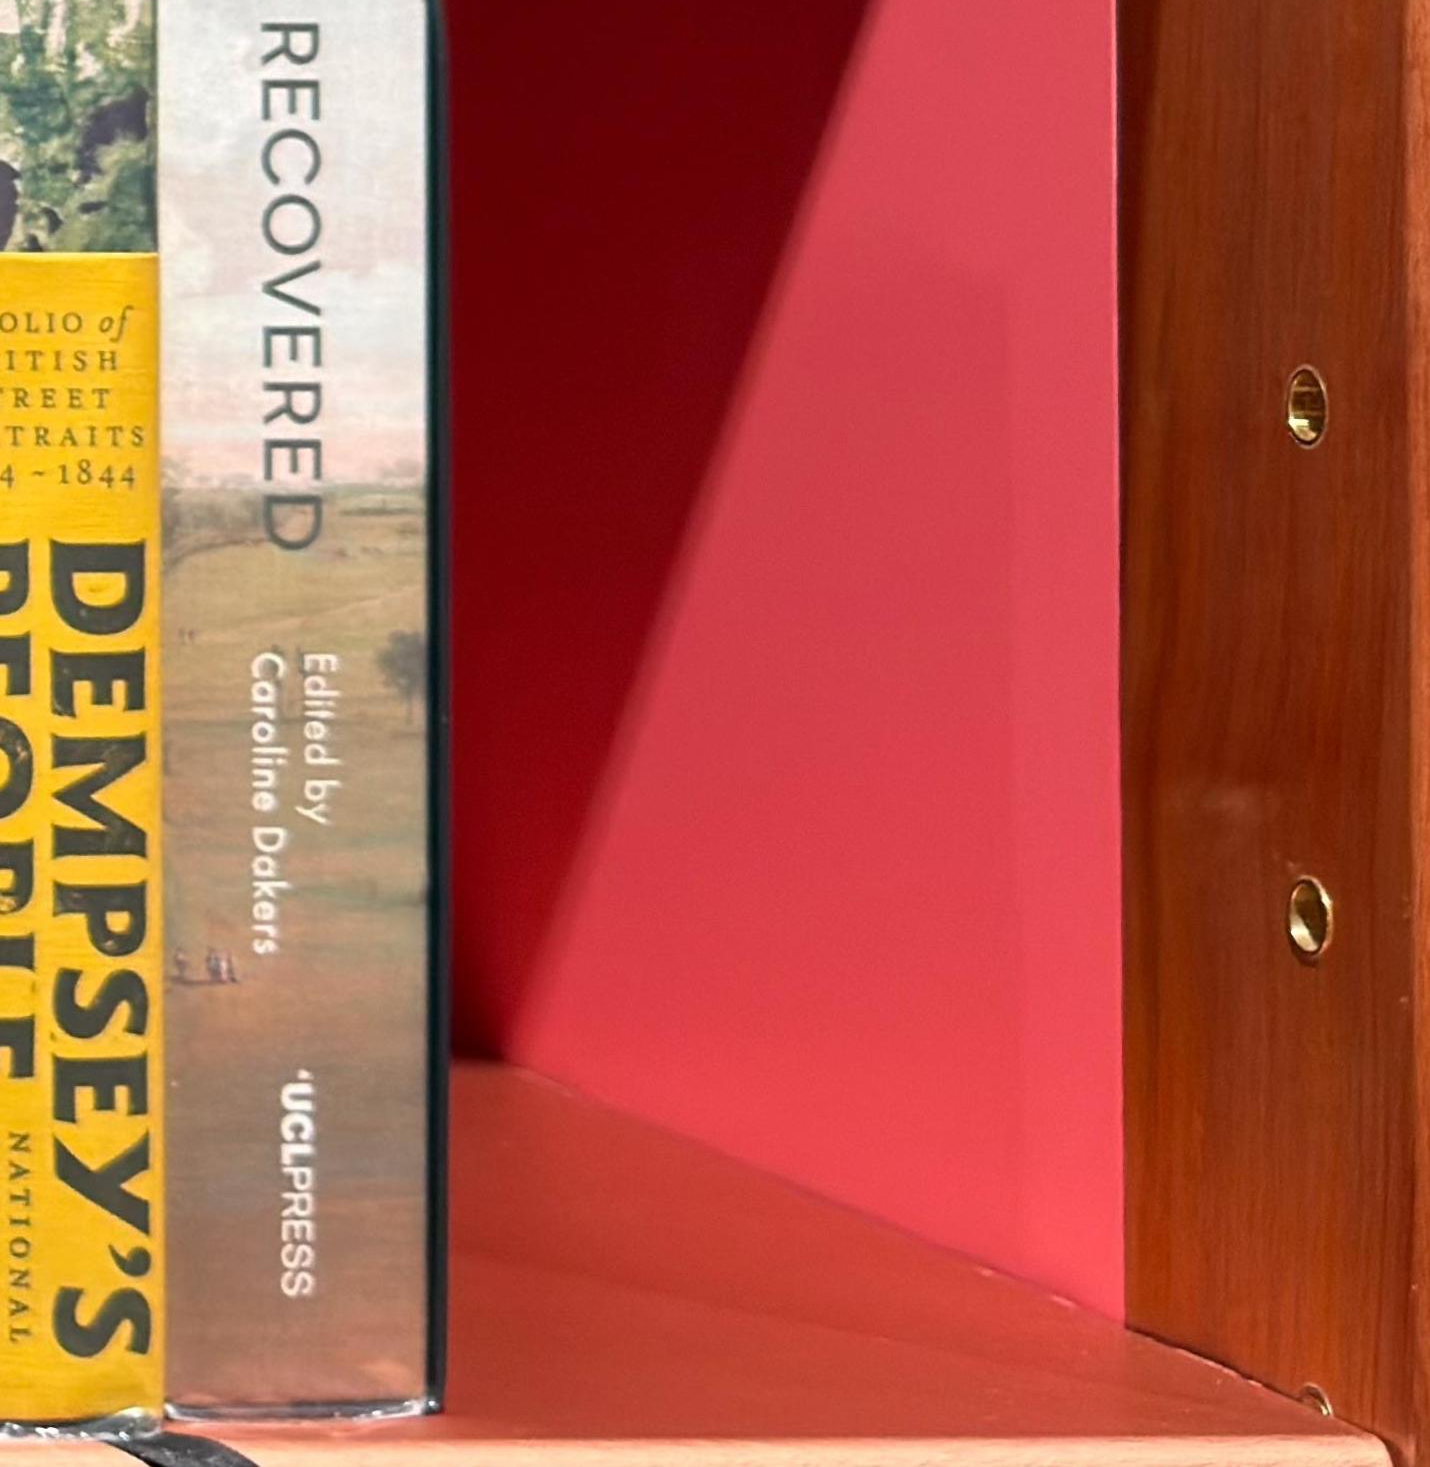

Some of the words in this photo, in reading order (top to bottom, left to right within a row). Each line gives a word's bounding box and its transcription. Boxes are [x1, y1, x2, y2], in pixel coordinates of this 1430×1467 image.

[99, 305, 134, 343] of
[260, 23, 322, 551] RECOVERED
[58, 459, 135, 489] 1844
[252, 652, 287, 813] Caroline
[303, 652, 341, 766] Edited
[296, 780, 341, 825] by
[50, 537, 152, 1357] DEMPSEY'S
[252, 826, 291, 955] Dakers
[8, 1131, 32, 1344] NATIONAL
